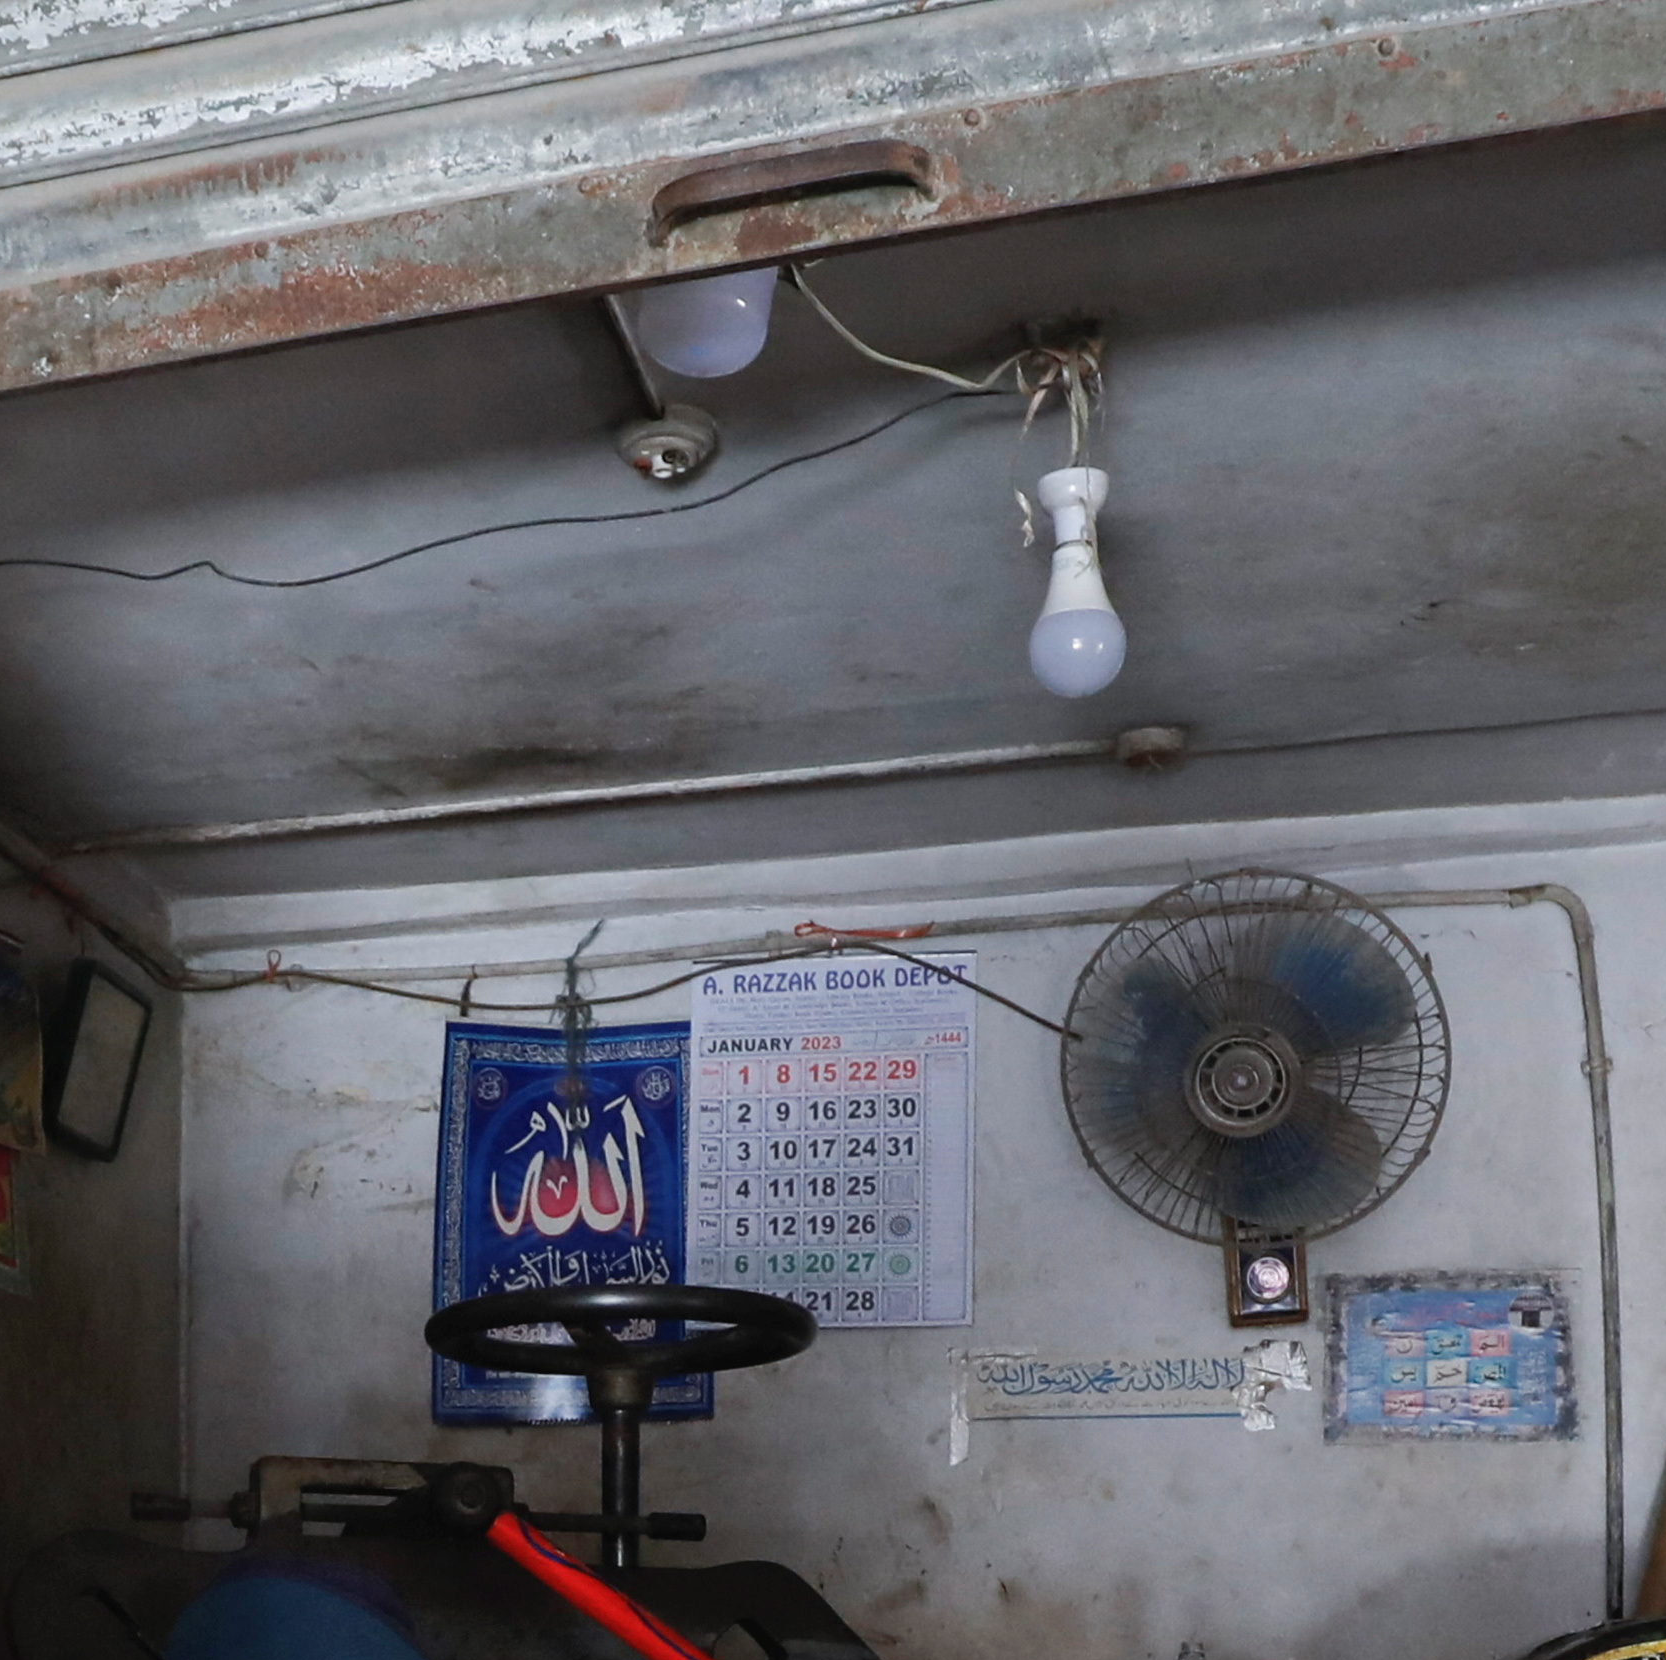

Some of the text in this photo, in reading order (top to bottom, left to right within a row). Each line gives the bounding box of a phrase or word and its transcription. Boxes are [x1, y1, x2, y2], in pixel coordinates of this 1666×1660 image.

[703, 964, 967, 995] A. RAZZAK BOOK DEPOT
[707, 1036, 794, 1054] JANUARY
[801, 1035, 842, 1050] 2023
[738, 1065, 749, 1085] 1
[776, 1064, 791, 1084] 8
[808, 1062, 837, 1083] 15
[848, 1061, 877, 1082] 22
[887, 1059, 917, 1080] 29
[737, 1103, 752, 1124] 2
[776, 1102, 791, 1122] 9
[808, 1100, 837, 1121] 16
[847, 1099, 877, 1120] 23
[887, 1097, 916, 1118] 30
[737, 1141, 751, 1161] 3
[769, 1140, 798, 1160] 10
[808, 1139, 837, 1159] 17
[847, 1137, 877, 1158] 24
[886, 1136, 913, 1157] 31
[735, 1179, 751, 1199] 4
[768, 1177, 794, 1198] 11
[807, 1176, 836, 1197] 18
[846, 1175, 876, 1196] 25
[736, 1217, 750, 1237] 5
[768, 1216, 797, 1236] 12
[807, 1215, 836, 1235] 19
[846, 1214, 876, 1235] 26
[734, 1254, 749, 1274] 6
[767, 1254, 796, 1274] 13
[805, 1253, 835, 1273] 20
[846, 1252, 876, 1273] 27
[805, 1290, 833, 1312] 21
[845, 1290, 875, 1311] 28
